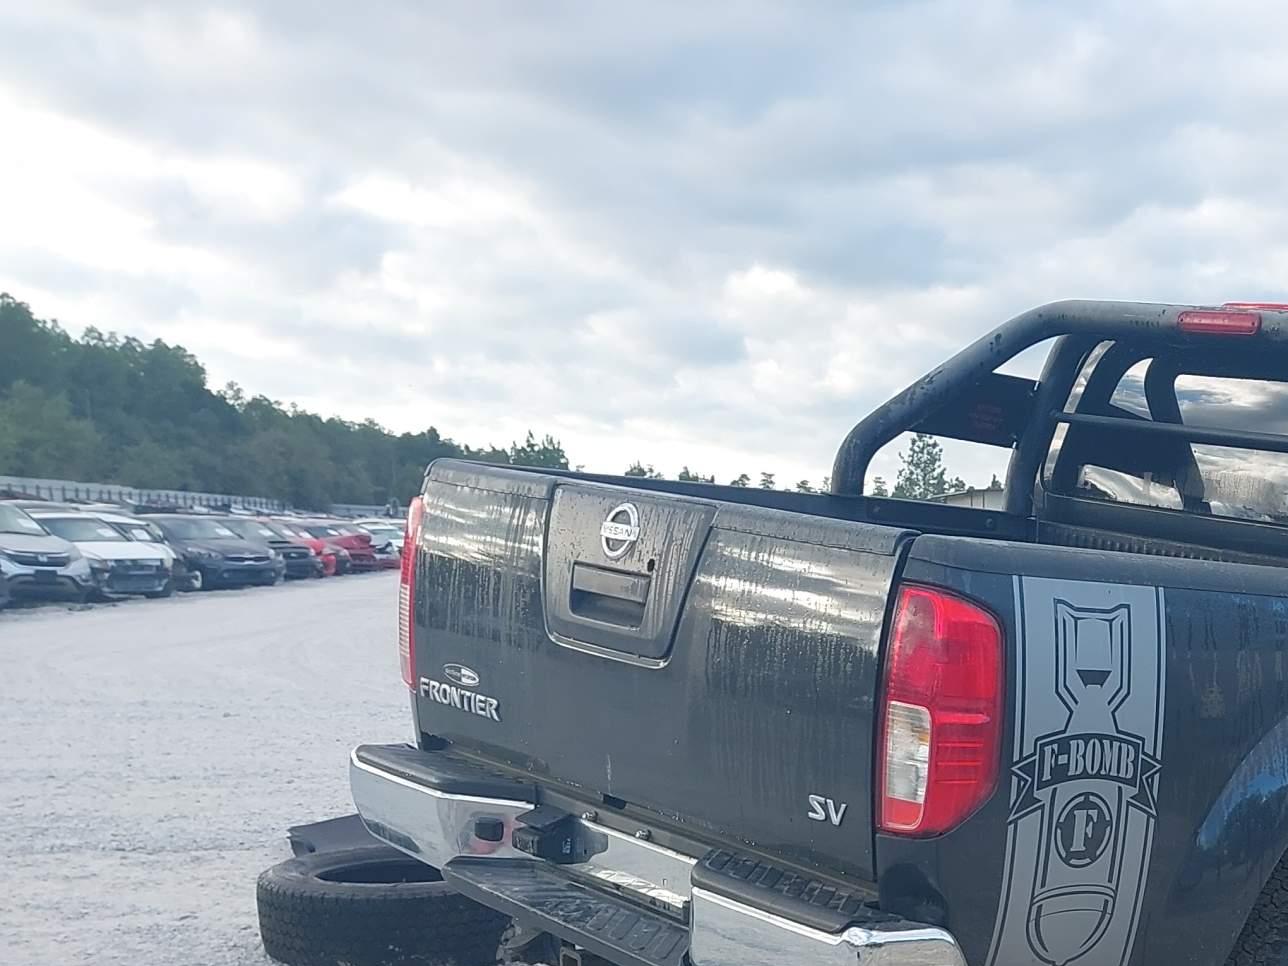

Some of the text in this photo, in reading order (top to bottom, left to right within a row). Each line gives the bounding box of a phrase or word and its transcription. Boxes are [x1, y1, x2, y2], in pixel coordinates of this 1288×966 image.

[420, 676, 501, 722] FRONTIER
[1042, 738, 1136, 782] F-BOMB
[808, 794, 847, 826] SV
[1070, 809, 1098, 852] F
